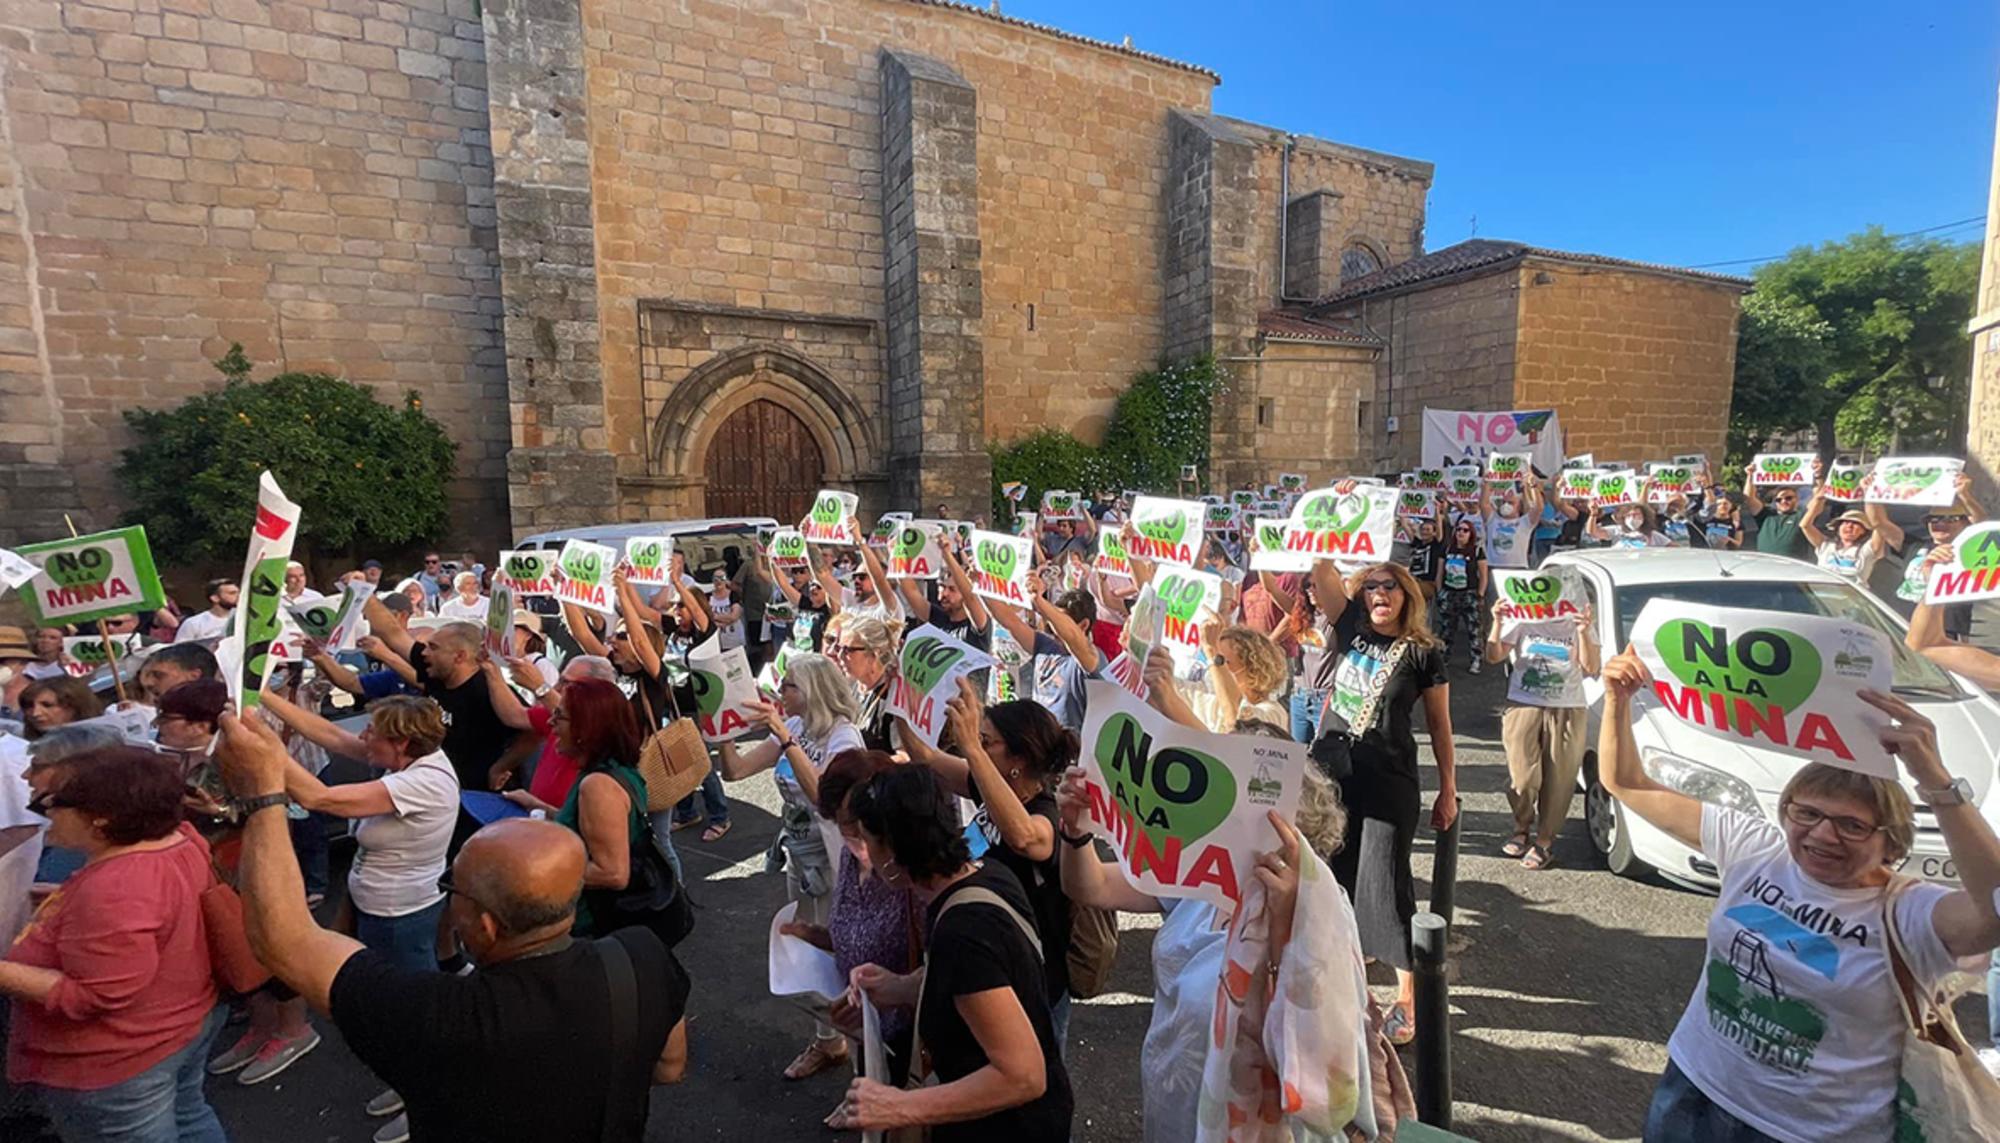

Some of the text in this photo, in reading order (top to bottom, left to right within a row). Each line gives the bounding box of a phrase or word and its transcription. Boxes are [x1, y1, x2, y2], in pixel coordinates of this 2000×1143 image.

[1457, 413, 1517, 445] NO
[1464, 445, 1474, 456] A
[1496, 457, 1517, 466] NO
[1768, 457, 1795, 466] NO
[1458, 479, 1475, 487] NO
[1488, 471, 1523, 479] MINA
[1602, 477, 1622, 487] NO
[1662, 469, 1686, 478] NO
[1756, 472, 1804, 482] MINA
[1830, 469, 1857, 482] NO
[1651, 482, 1693, 491] MINA
[816, 497, 837, 514] NO
[1406, 493, 1423, 502] NO
[1593, 492, 1632, 505] MINA
[805, 521, 846, 540] MINA
[780, 537, 800, 549] NO
[1131, 536, 1192, 565] MINA
[1287, 530, 1375, 555] MINA
[55, 547, 102, 573] NO
[984, 542, 1010, 565] NO
[511, 557, 538, 570] NO
[626, 565, 664, 580] MINA
[46, 577, 132, 608] MINA
[560, 579, 606, 607] MINA
[977, 571, 1024, 602] MINA
[1513, 577, 1551, 593] NO
[1503, 599, 1579, 619] MINA
[1165, 614, 1200, 648] INA
[911, 638, 959, 669] NO
[1681, 622, 1793, 677] NO
[1694, 670, 1769, 698] A LA
[1653, 680, 1858, 762] MINA
[1112, 718, 1209, 804] NO
[1116, 781, 1170, 829] A LA
[1085, 780, 1242, 902] MINA
[1744, 876, 1784, 906] NO
[1793, 903, 1868, 947] MINA
